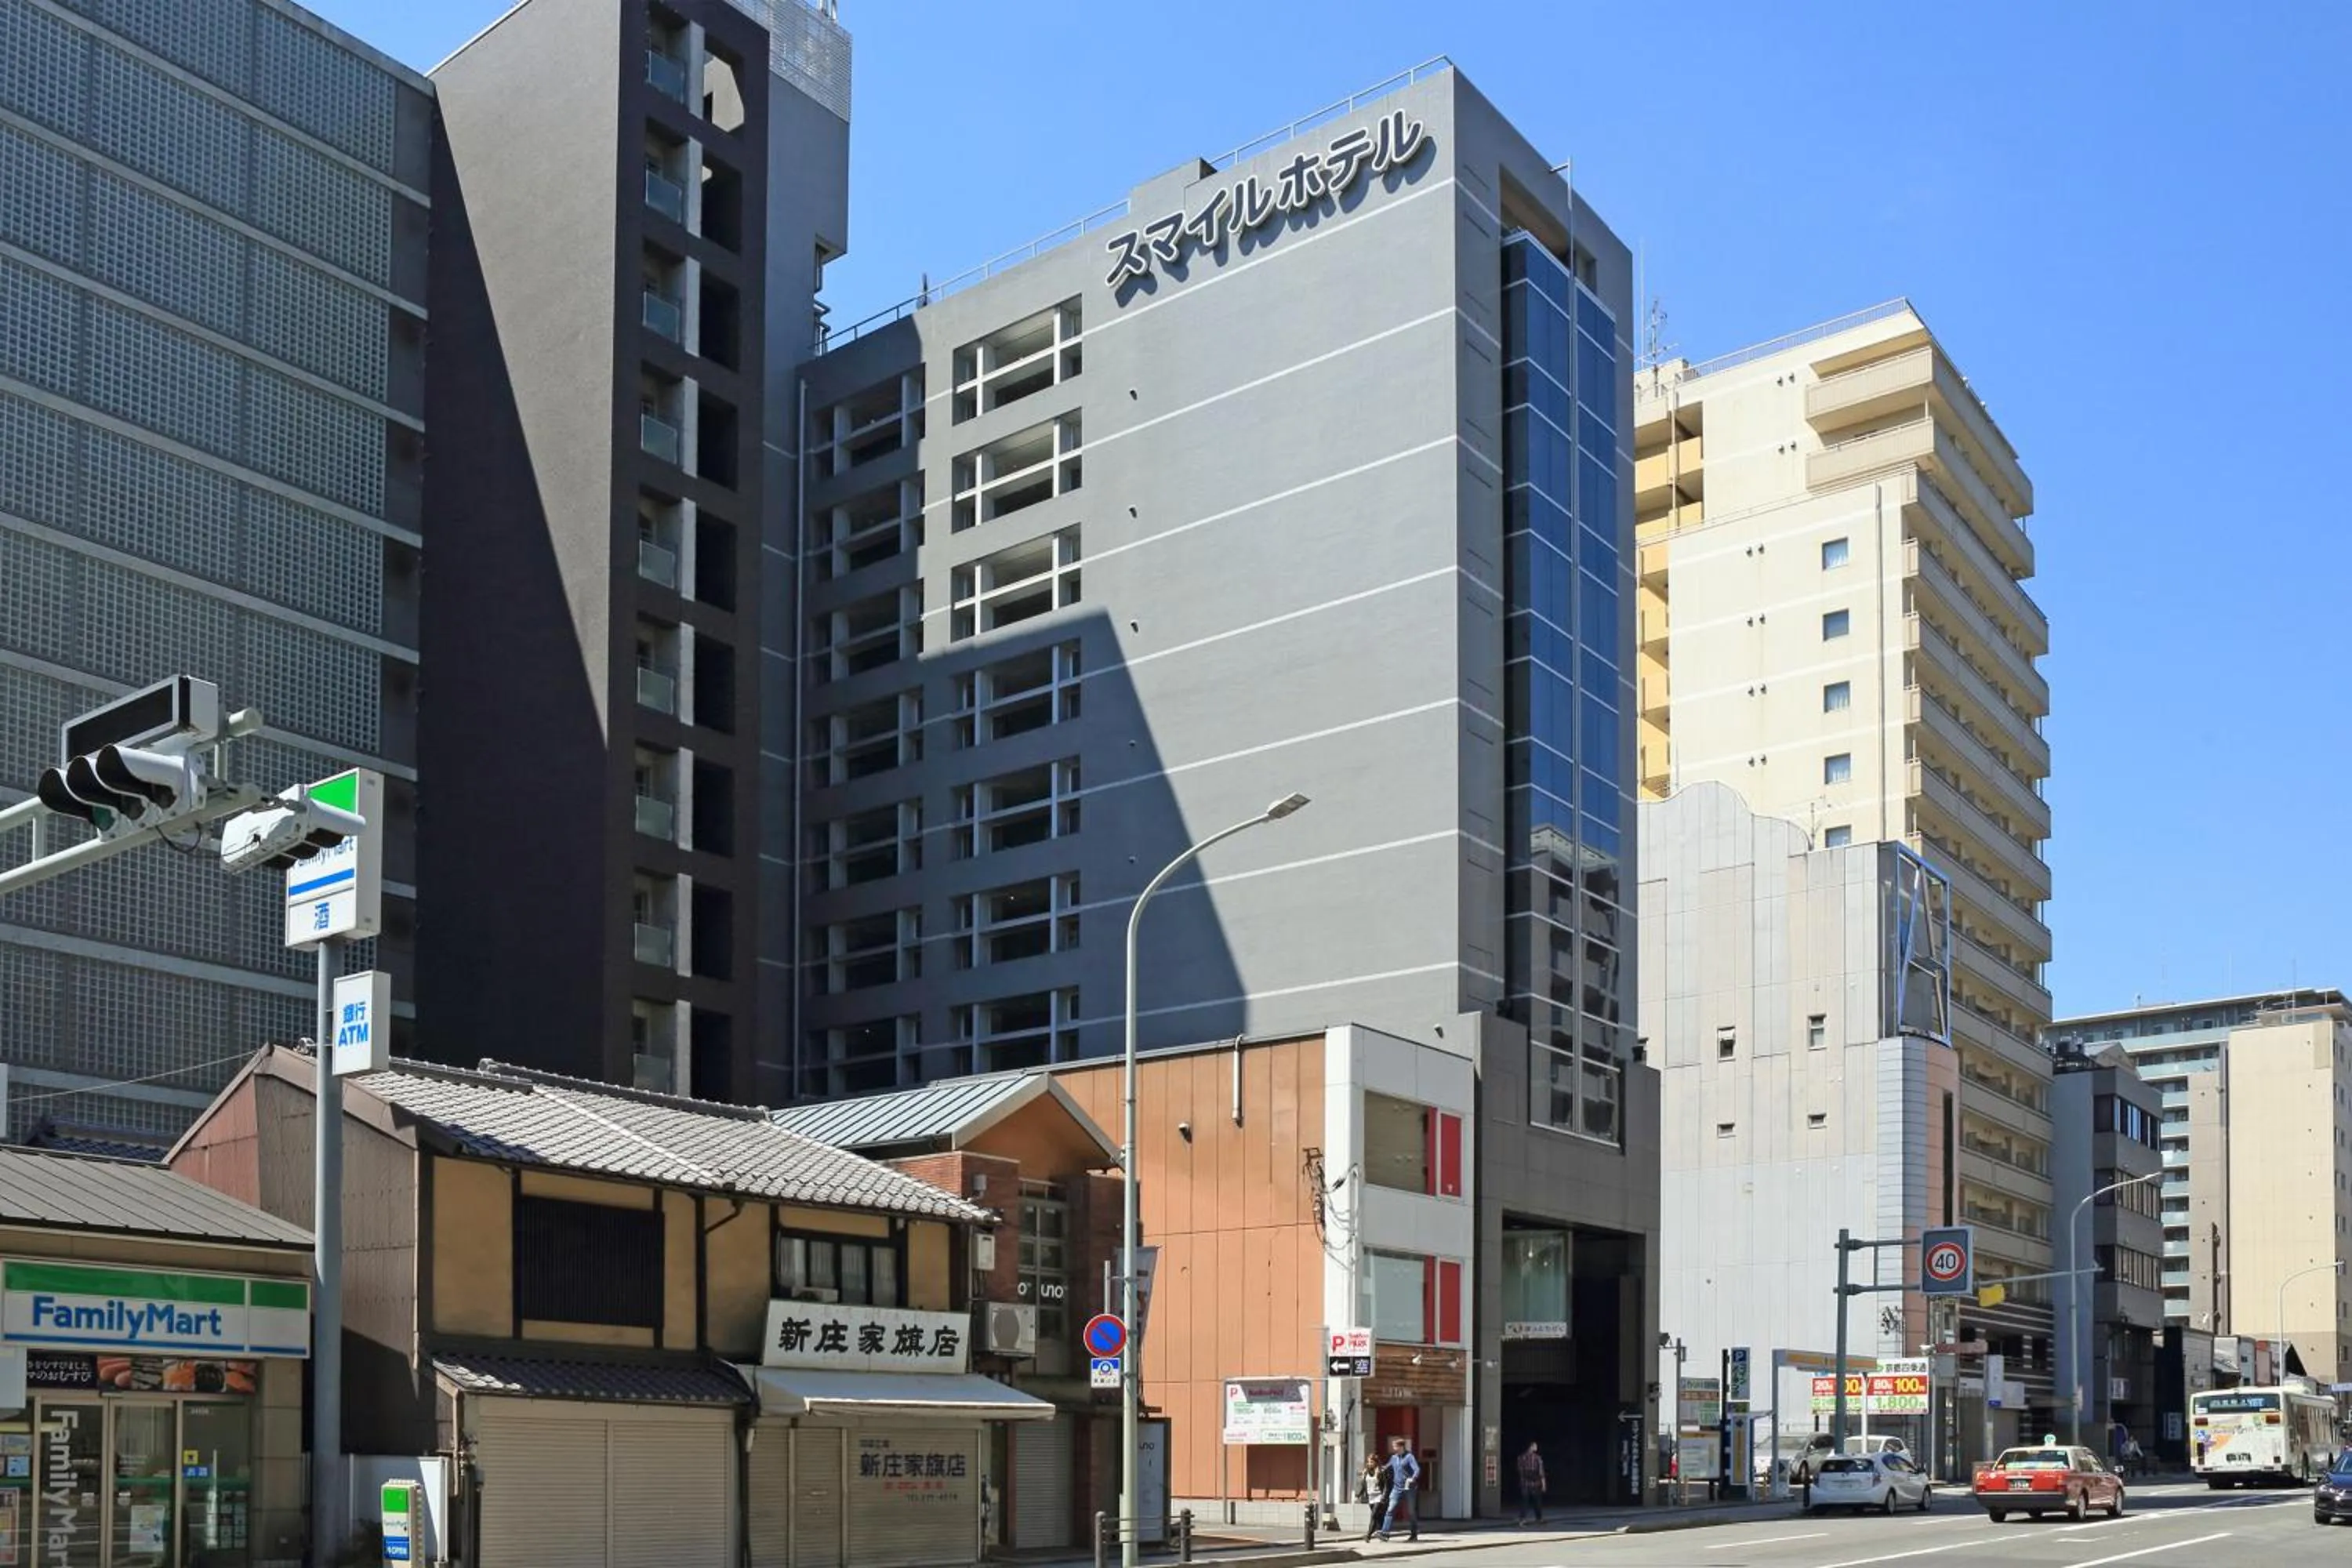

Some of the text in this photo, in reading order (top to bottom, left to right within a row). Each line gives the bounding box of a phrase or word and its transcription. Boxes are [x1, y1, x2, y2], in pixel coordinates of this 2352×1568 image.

[1105, 108, 1424, 288] スマイルホテル
[314, 902, 329, 930] 酒
[343, 1001, 365, 1023] 銀行
[339, 1022, 368, 1047] ATM
[1935, 1253, 1956, 1269] 40
[32, 1294, 222, 1339] FamilyMart
[778, 1316, 960, 1358] 新庄家旗店
[1332, 1335, 1345, 1352] P
[860, 1453, 967, 1478] 新庄家旗店
[42, 1410, 78, 1568] FamilyMar
